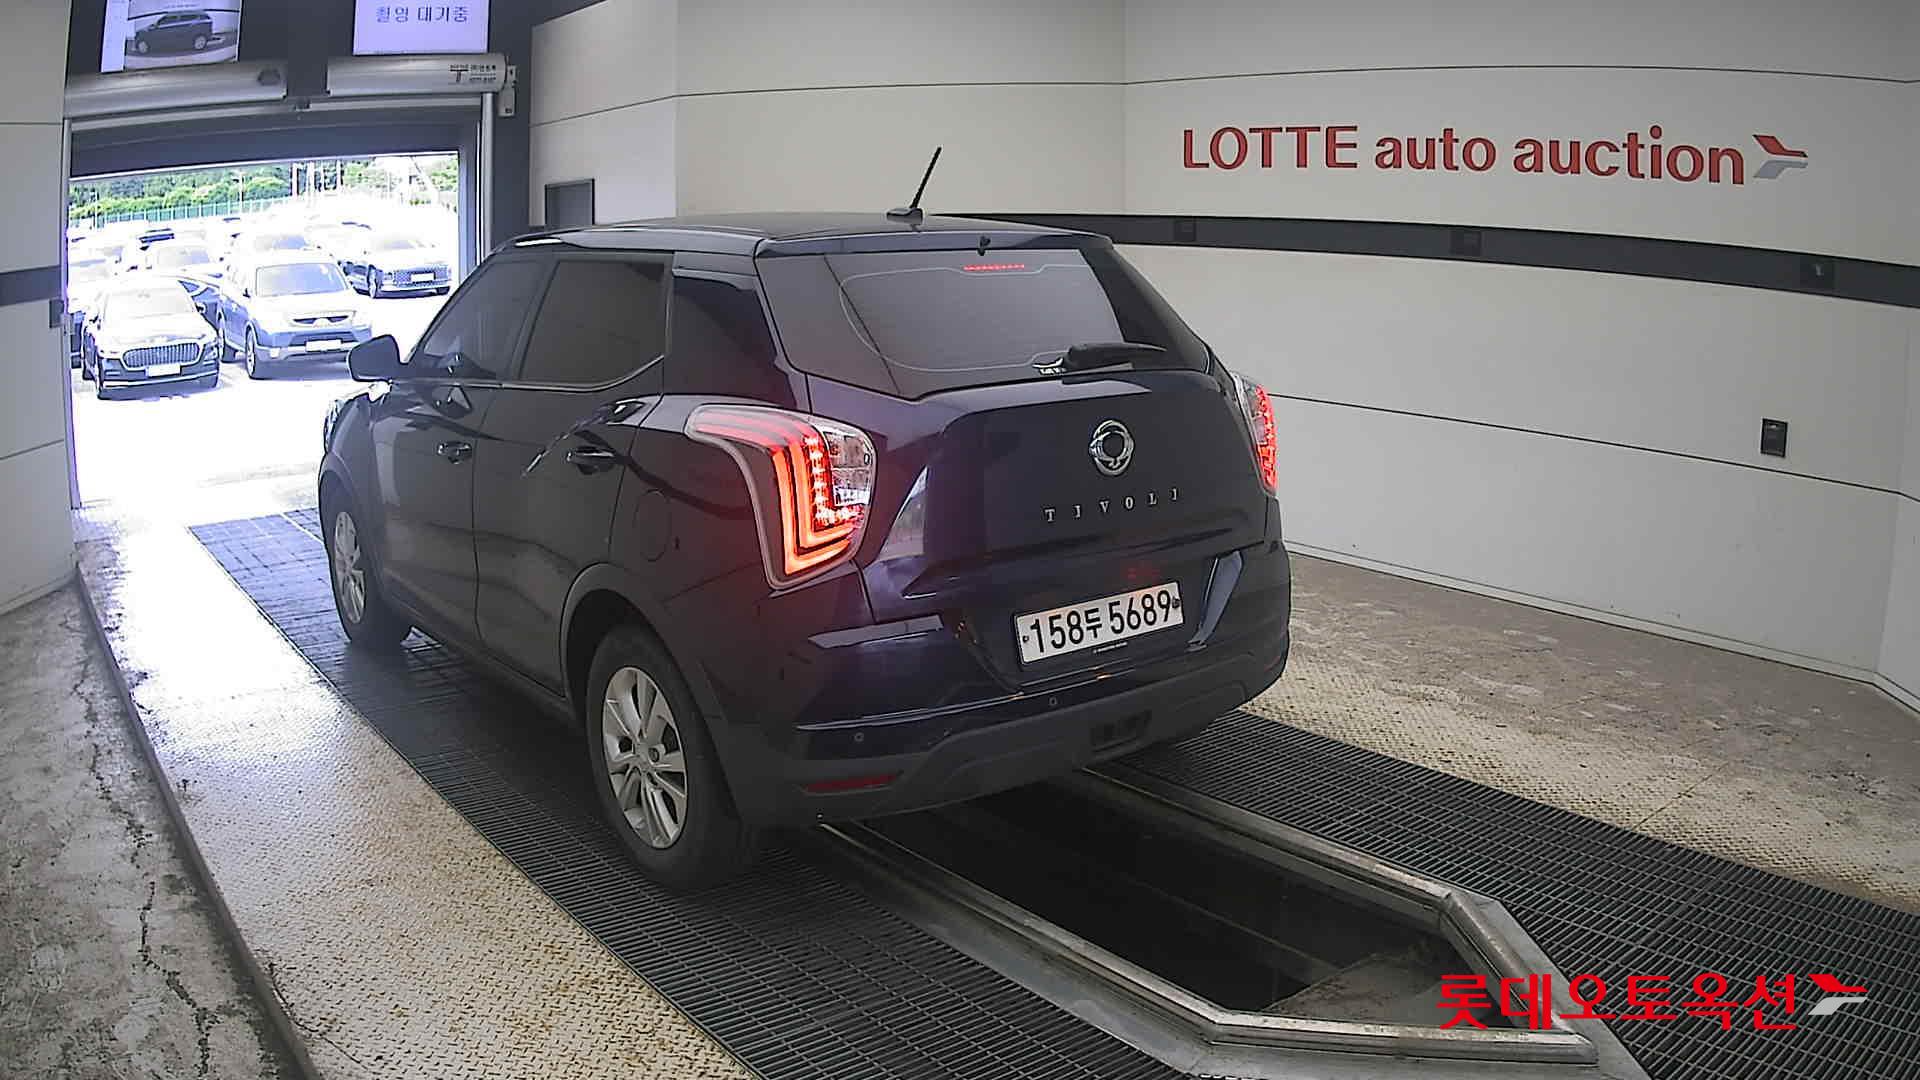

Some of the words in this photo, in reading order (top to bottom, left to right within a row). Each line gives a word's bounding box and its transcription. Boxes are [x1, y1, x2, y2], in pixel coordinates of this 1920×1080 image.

[417, 5, 469, 23] 대기중
[1182, 125, 1358, 170] LOTTE
[1374, 127, 1497, 173] auto
[1512, 124, 1746, 186] auction
[1044, 488, 1178, 522] TIVOLI
[1030, 607, 1102, 654] 158두
[1108, 589, 1172, 635] 5689
